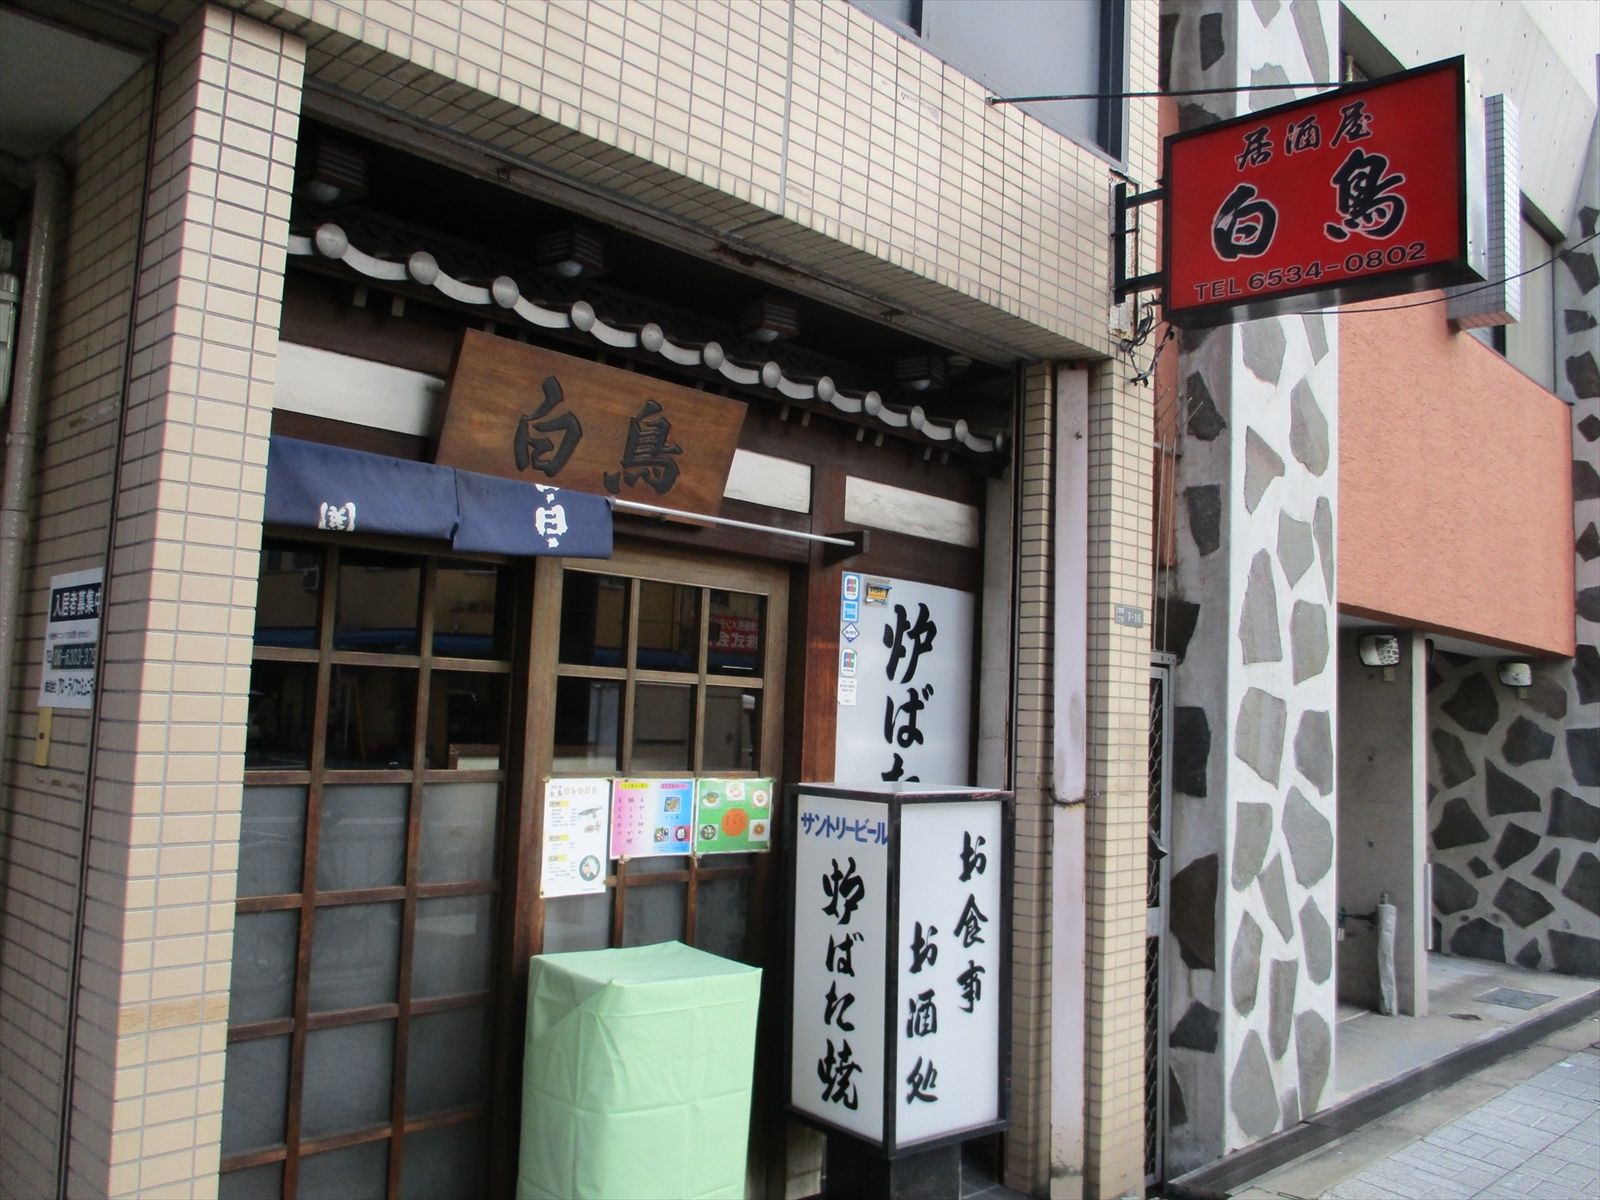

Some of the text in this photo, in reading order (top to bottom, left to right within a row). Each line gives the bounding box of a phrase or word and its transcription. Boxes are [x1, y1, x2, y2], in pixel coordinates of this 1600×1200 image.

[1235, 100, 1373, 171] 居酒屋
[1211, 147, 1407, 262] 白鳥
[1194, 242, 1427, 301] TEL 6534-0802
[513, 375, 682, 495] 白鳥
[801, 812, 889, 846] サントリービール
[953, 831, 989, 1014] お食事
[818, 856, 866, 1111] 炉ばた焼
[906, 921, 939, 1104] お酒処
